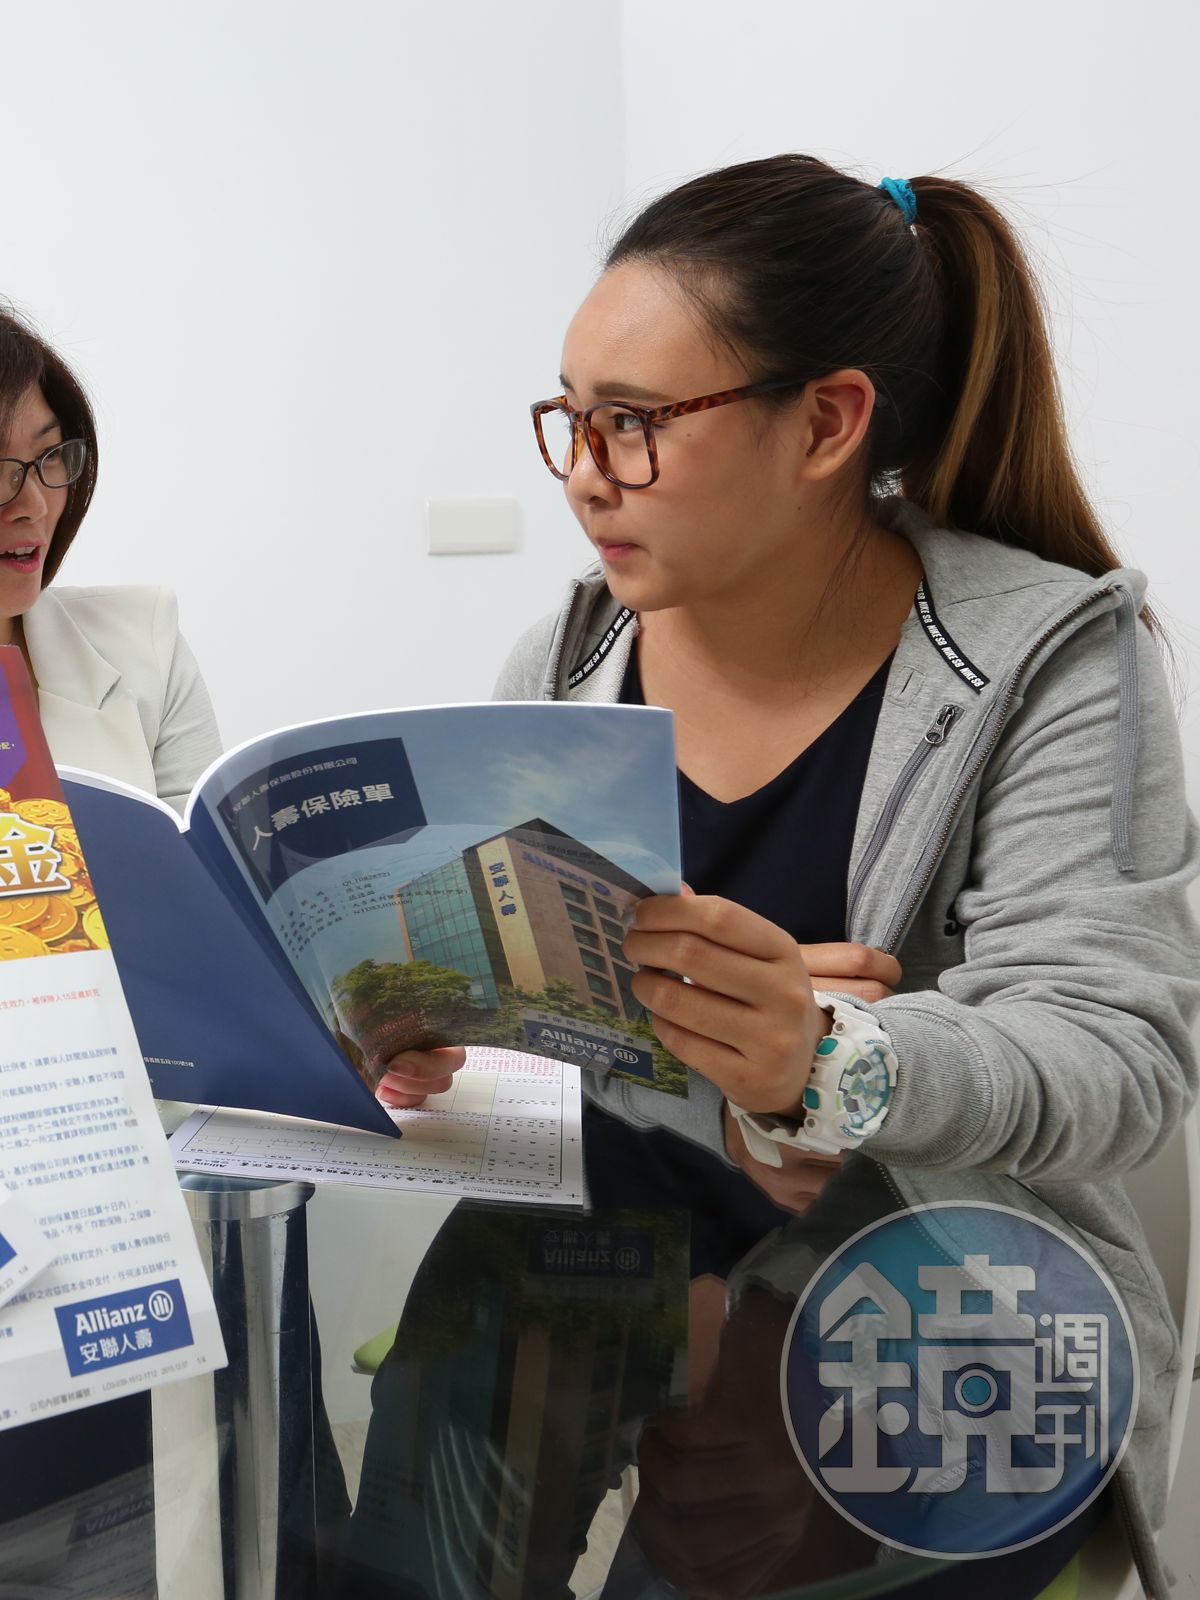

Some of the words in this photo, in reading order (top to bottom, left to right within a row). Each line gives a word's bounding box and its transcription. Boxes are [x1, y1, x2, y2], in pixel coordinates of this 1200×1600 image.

[918, 601, 930, 614] NIKE
[613, 615, 625, 631] NIKE
[622, 608, 631, 619] SB
[922, 614, 933, 624] SB
[599, 638, 610, 654] NIKE
[607, 630, 615, 642] SB
[926, 624, 942, 638] NIKE
[935, 637, 948, 646] SB
[583, 659, 595, 674] NIKE
[592, 652, 600, 663] SB
[941, 646, 958, 660] NIKE
[951, 658, 965, 668] SB
[575, 670, 583, 681] SB
[960, 667, 977, 681] NIKE
[971, 678, 985, 687] SB
[251, 782, 395, 852] 人壽保險單
[539, 1028, 609, 1054] Allianz
[76, 1300, 148, 1337] Allianz
[80, 1328, 153, 1365] 安聯人壽
